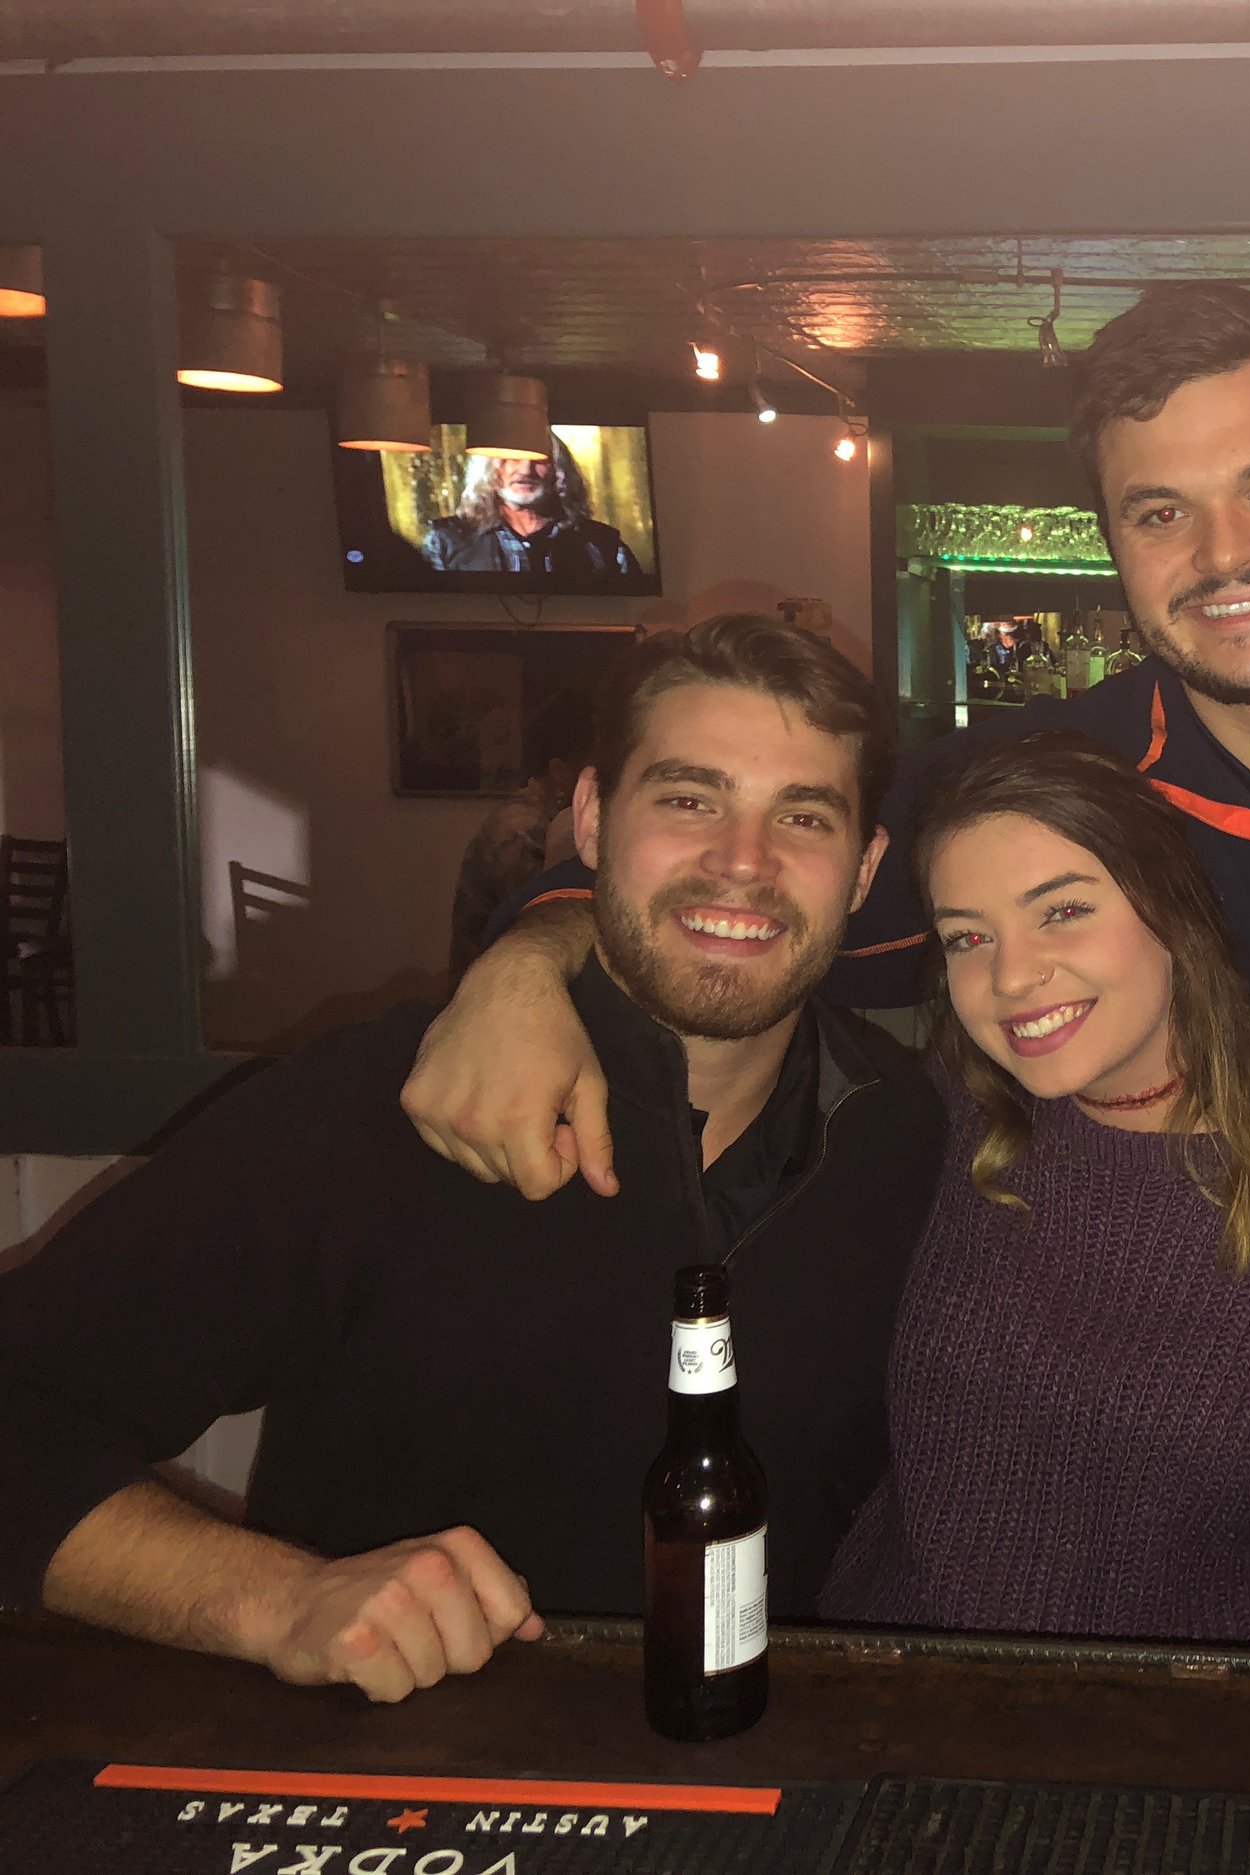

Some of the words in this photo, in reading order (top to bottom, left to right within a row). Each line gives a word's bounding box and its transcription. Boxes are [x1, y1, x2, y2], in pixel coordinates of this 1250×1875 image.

[176, 1799, 350, 1827] TEXAS
[465, 1809, 649, 1838] AUSTIN
[229, 1842, 517, 1875] VODKA
